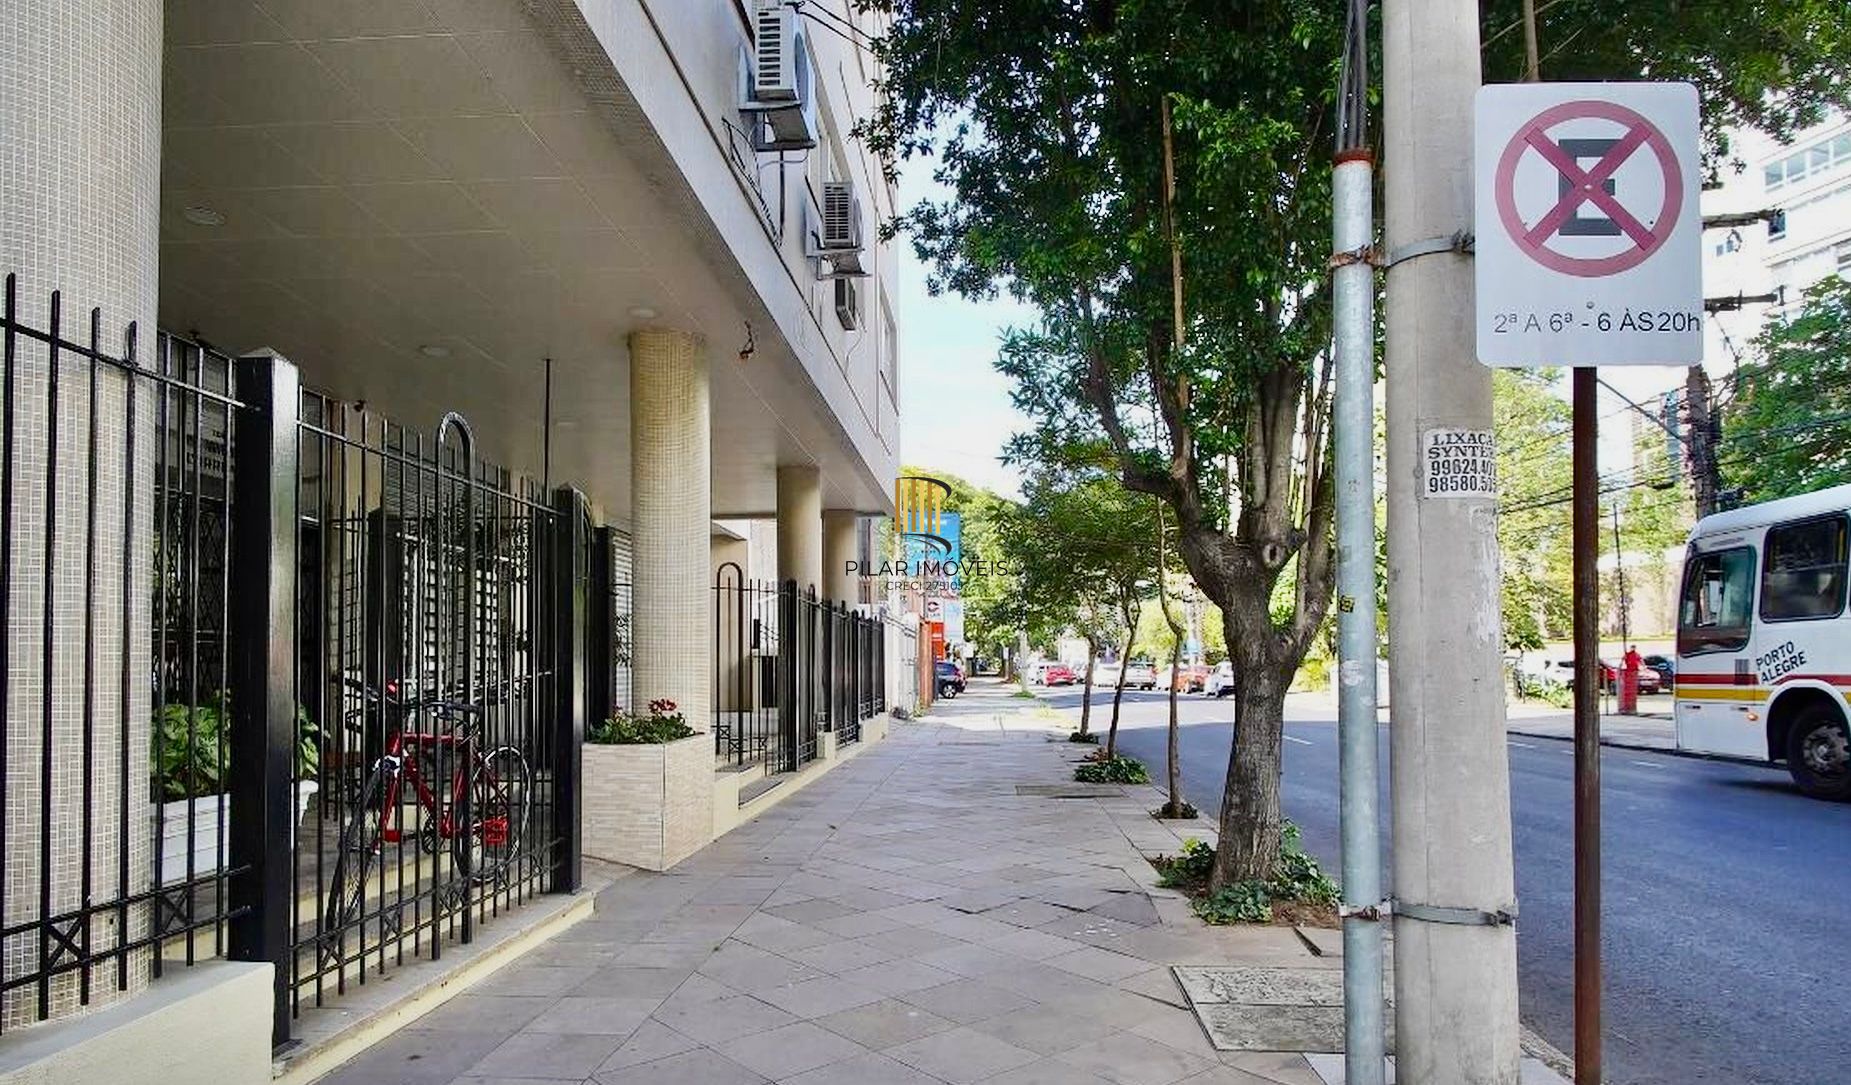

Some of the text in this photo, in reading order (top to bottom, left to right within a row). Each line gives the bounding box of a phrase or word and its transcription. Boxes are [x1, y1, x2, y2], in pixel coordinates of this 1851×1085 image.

[1494, 313, 1518, 333] 2ª
[1524, 313, 1542, 333] A
[1549, 312, 1573, 333] 6ª
[1597, 312, 1611, 332] 6
[1657, 311, 1701, 332] 20h
[1756, 641, 1795, 671] PORTO
[1761, 650, 1807, 682] ALEGRE
